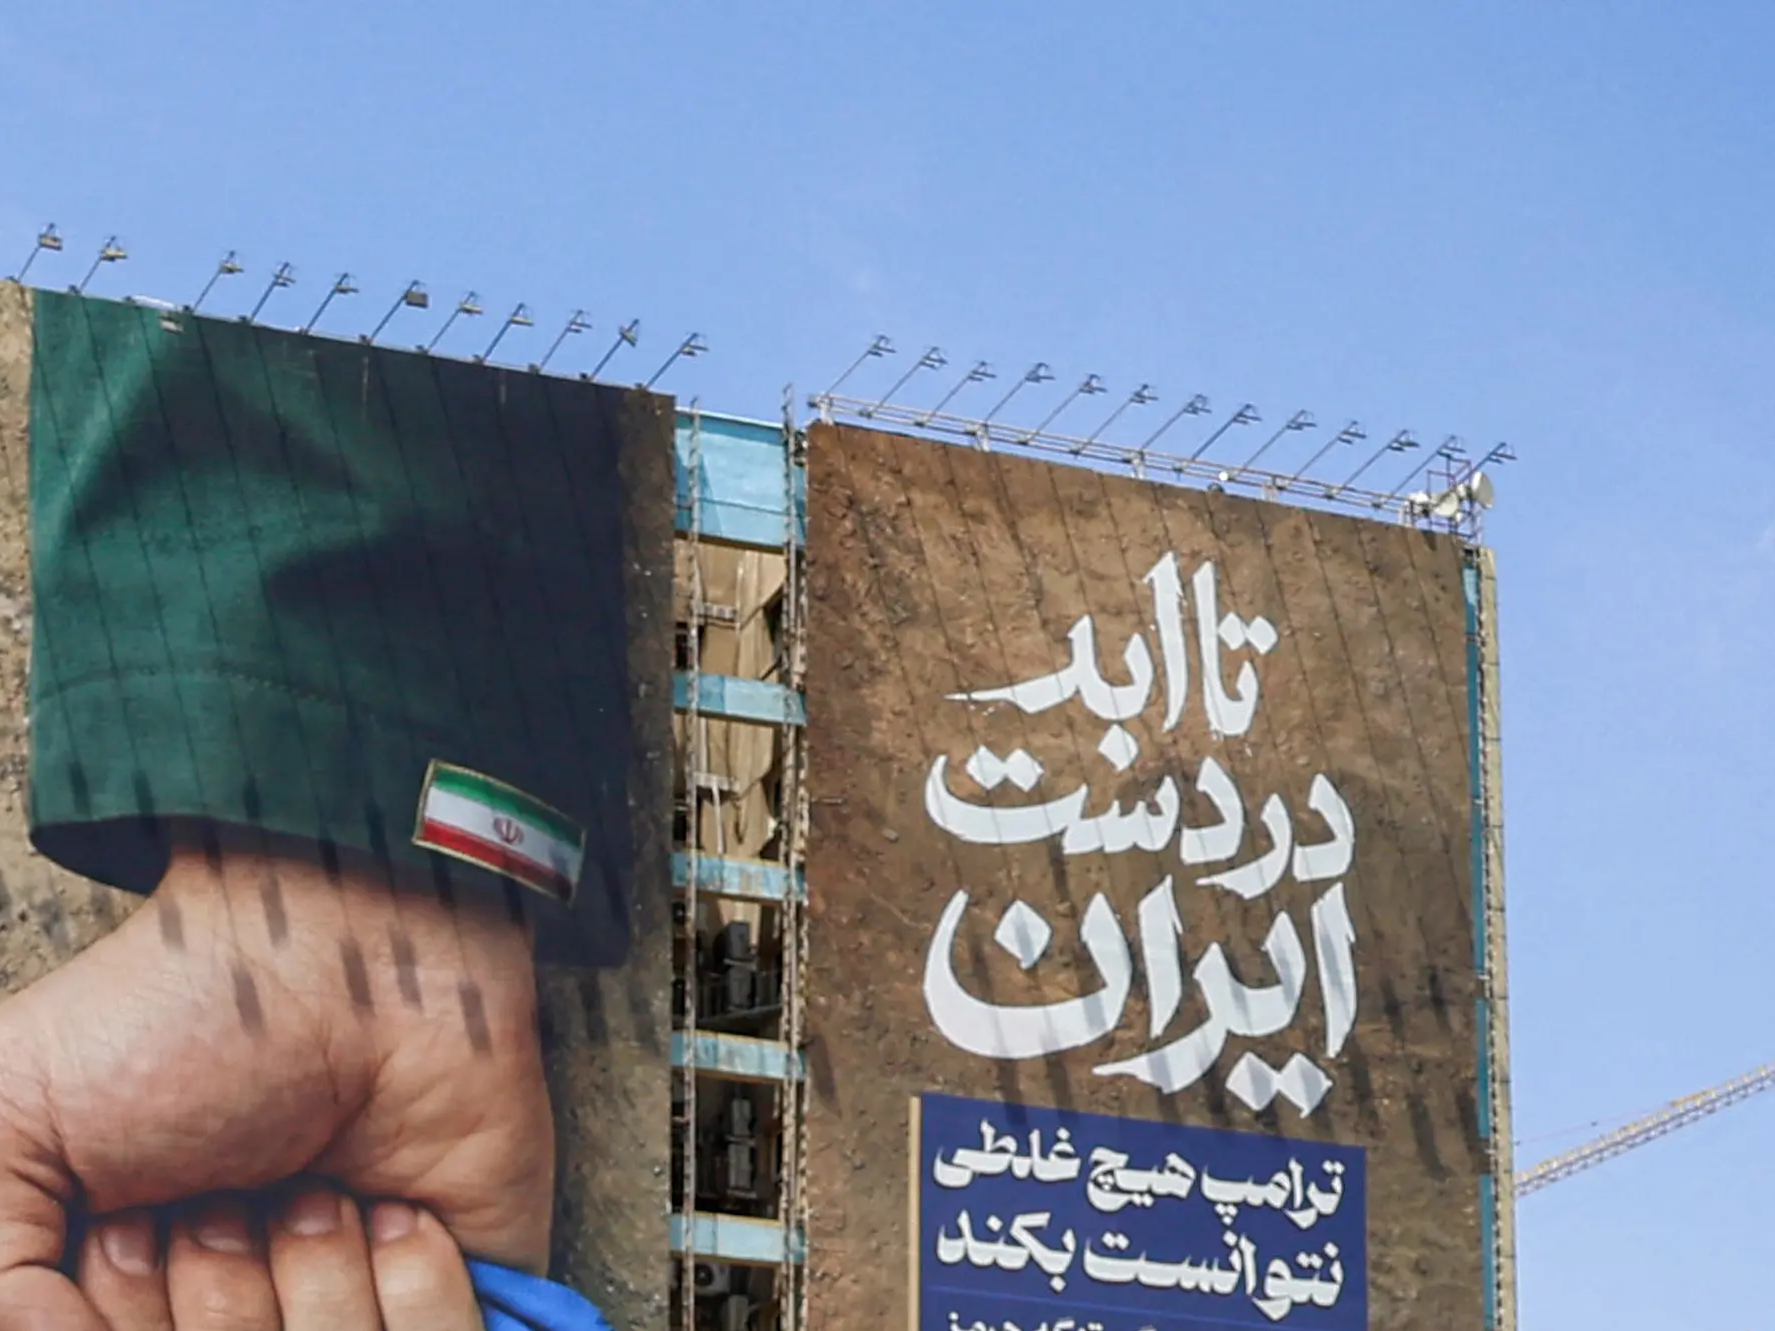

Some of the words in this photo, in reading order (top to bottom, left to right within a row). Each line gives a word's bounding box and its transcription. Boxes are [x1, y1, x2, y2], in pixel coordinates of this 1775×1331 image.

[944, 551, 1187, 771] ابد
[1192, 560, 1278, 736] تا
[924, 745, 1244, 864] دست
[1196, 773, 1355, 899] در
[924, 874, 1357, 1117] ایران
[933, 1118, 1081, 1187] غلطی
[1086, 1146, 1195, 1211] هیچ
[1201, 1157, 1345, 1229] ترامپ
[937, 1210, 1076, 1291] بکند
[1083, 1230, 1344, 1320] نتوانست
